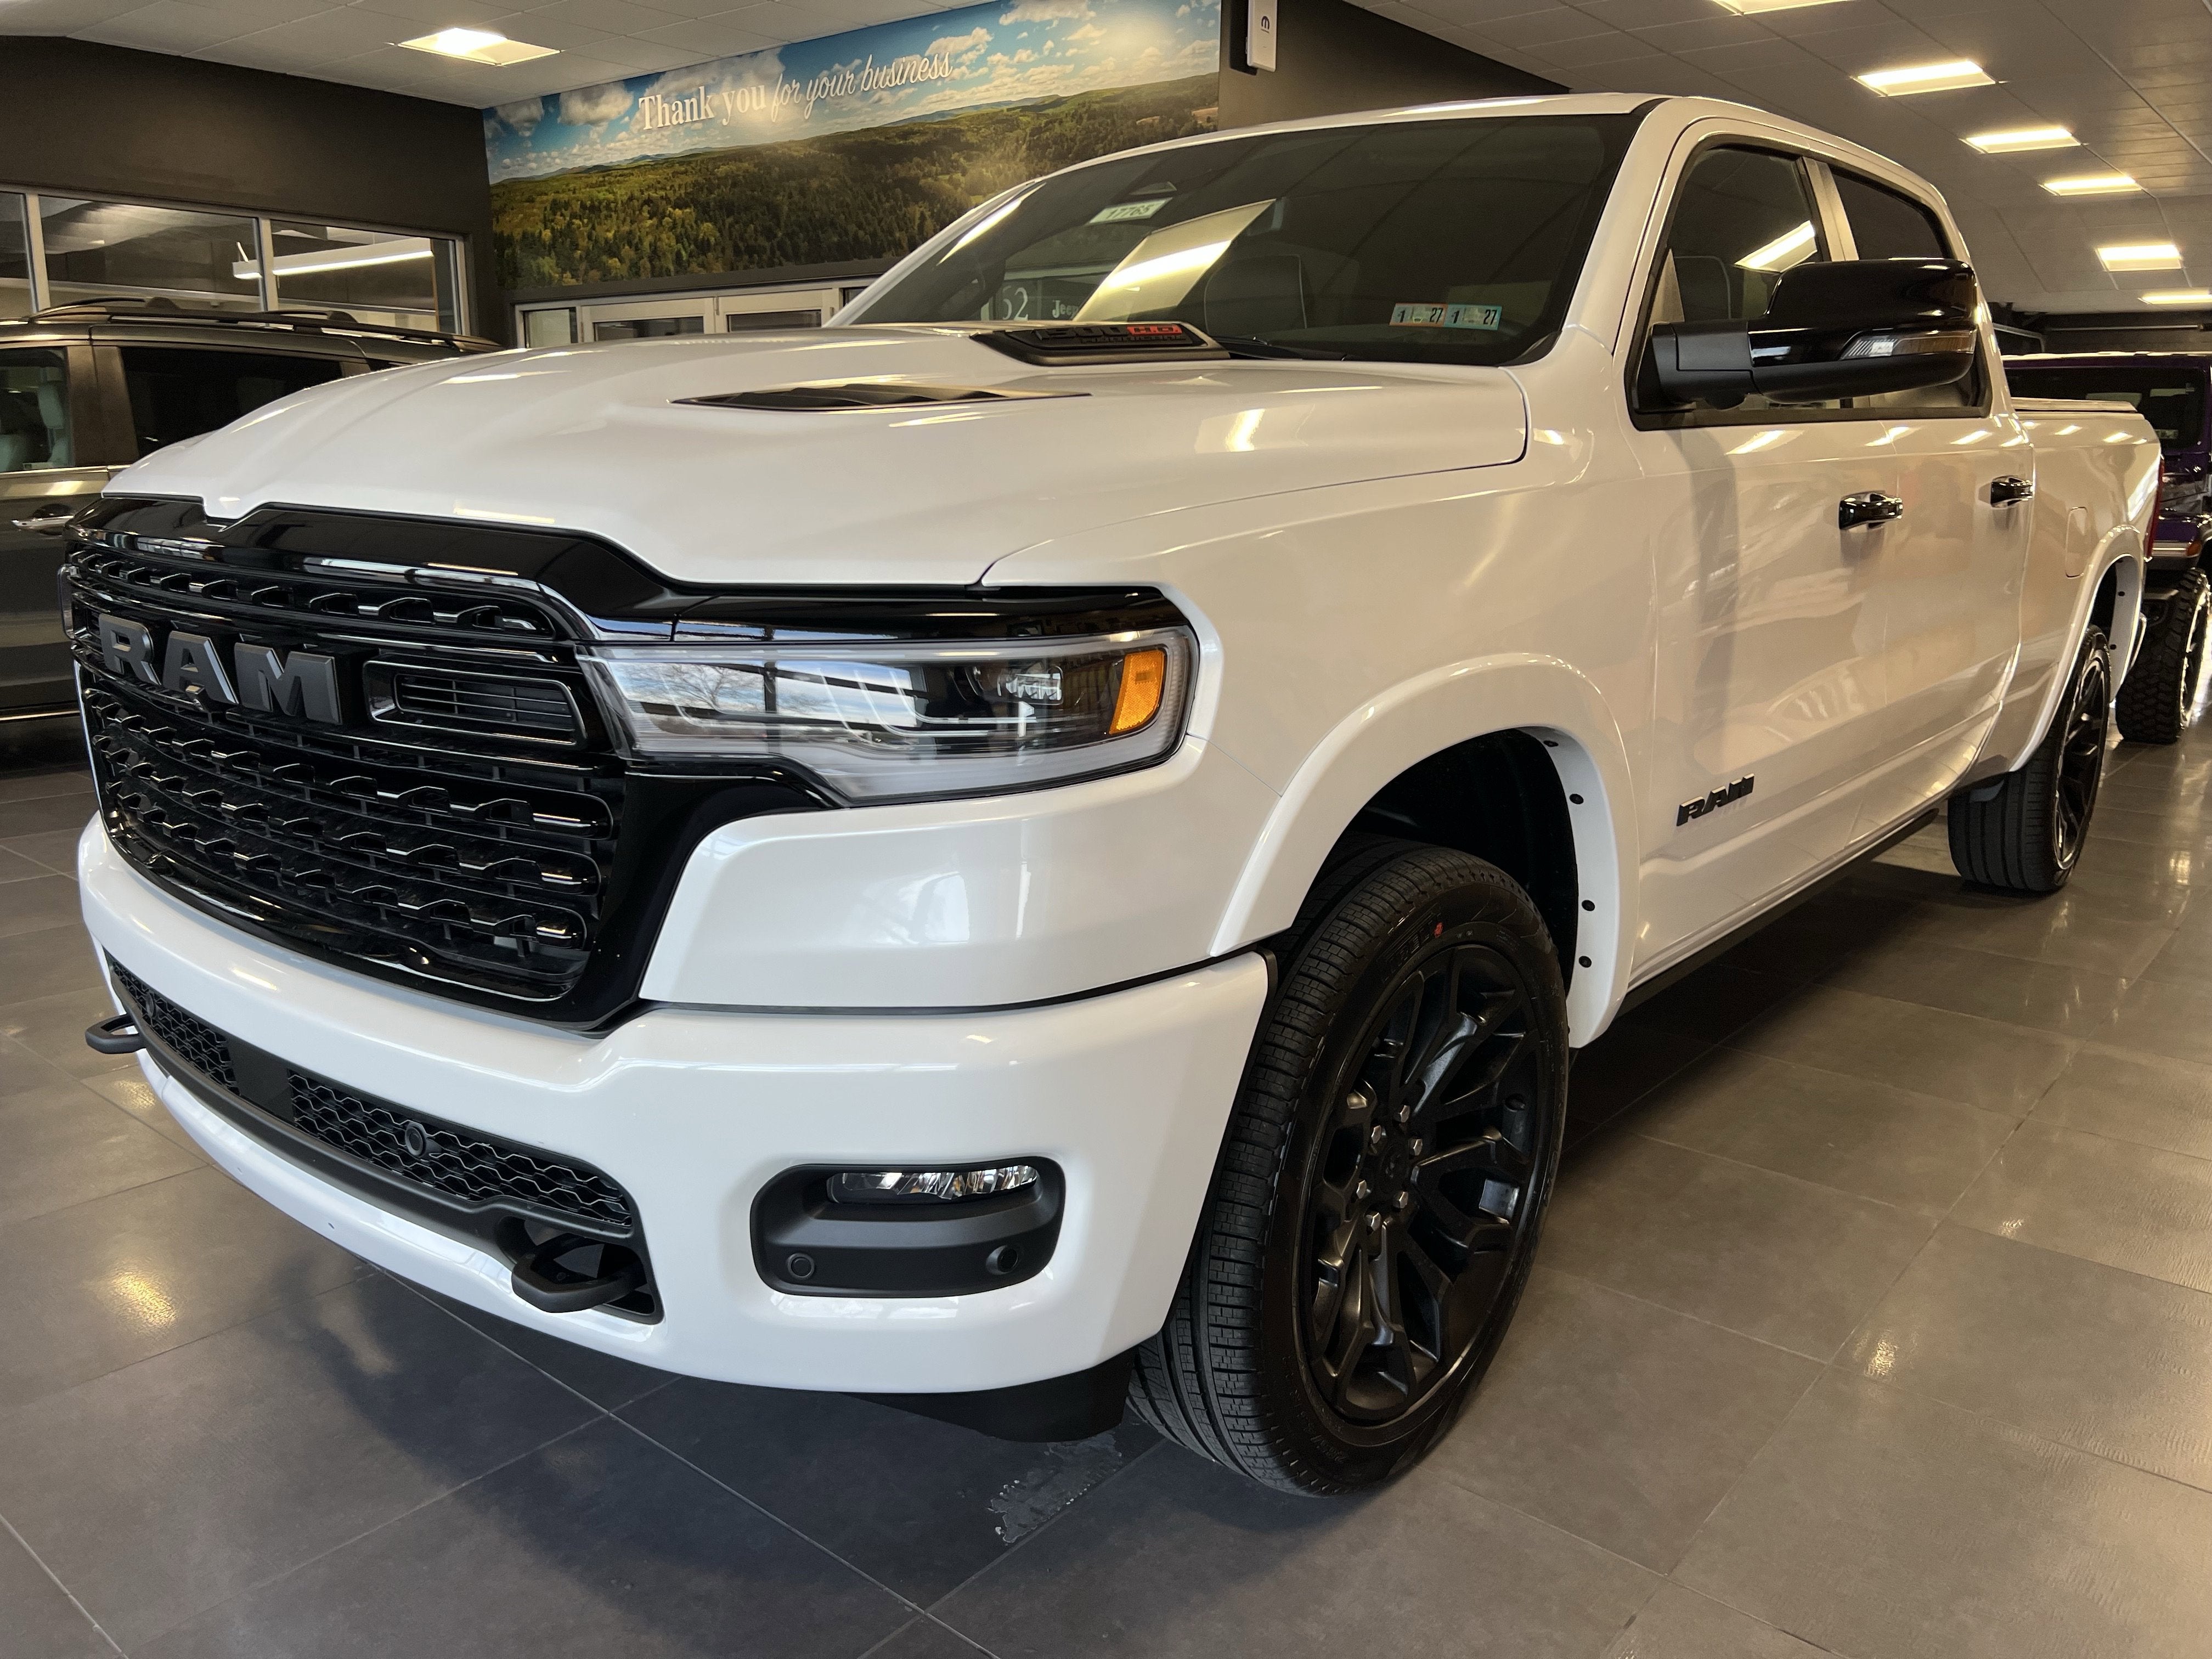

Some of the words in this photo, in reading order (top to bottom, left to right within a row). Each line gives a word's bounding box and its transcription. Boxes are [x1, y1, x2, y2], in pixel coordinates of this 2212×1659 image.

[638, 85, 716, 131] Thank
[721, 83, 766, 126] you
[771, 72, 803, 123] for
[803, 69, 856, 121] your
[860, 52, 954, 92] business
[1052, 300, 1080, 321] Jeep
[1429, 307, 1444, 324] 27
[1483, 309, 1498, 325] 27
[99, 613, 342, 725] RAM
[1676, 773, 1754, 826] RAM
